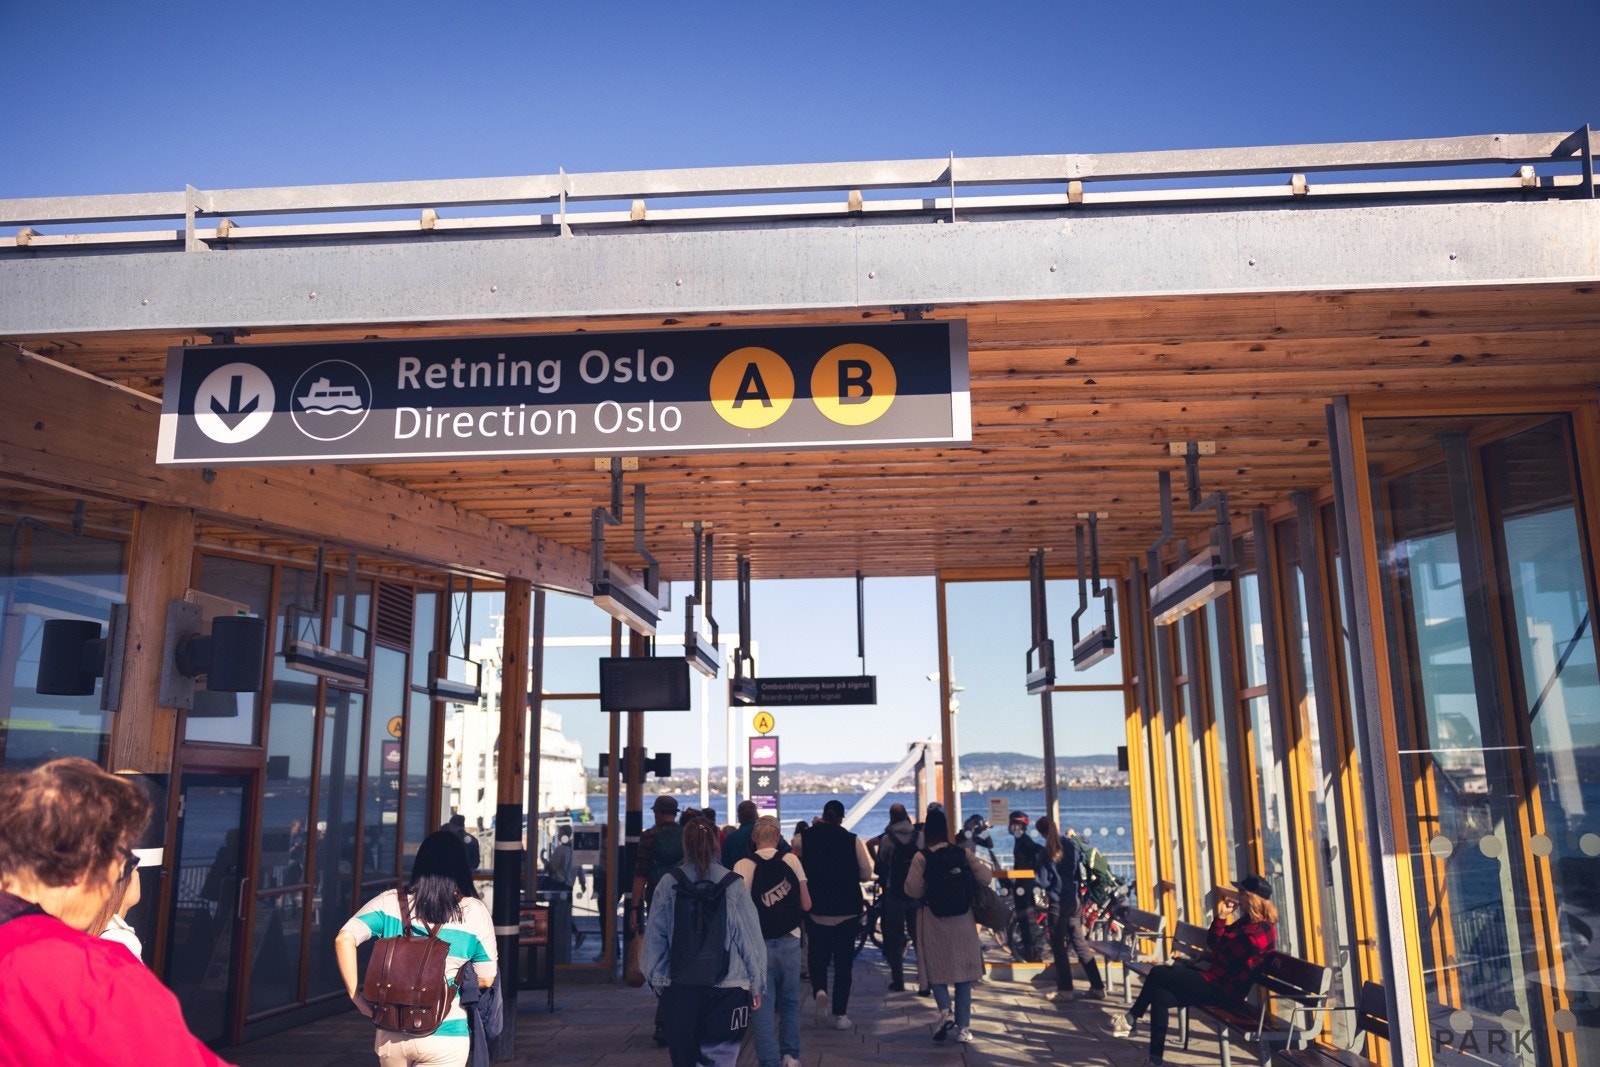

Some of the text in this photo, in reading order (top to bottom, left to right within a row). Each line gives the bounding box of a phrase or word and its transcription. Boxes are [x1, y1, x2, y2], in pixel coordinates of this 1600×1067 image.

[397, 349, 675, 393] Retning Oslo
[732, 359, 873, 408] A B
[394, 399, 682, 439] Direction Oslo
[761, 681, 870, 691] Ombordstigning kun på signal
[761, 693, 792, 701] Boarding
[794, 693, 808, 701] only
[821, 693, 841, 701] signal
[759, 717, 768, 728] A
[761, 876, 791, 907] VANS
